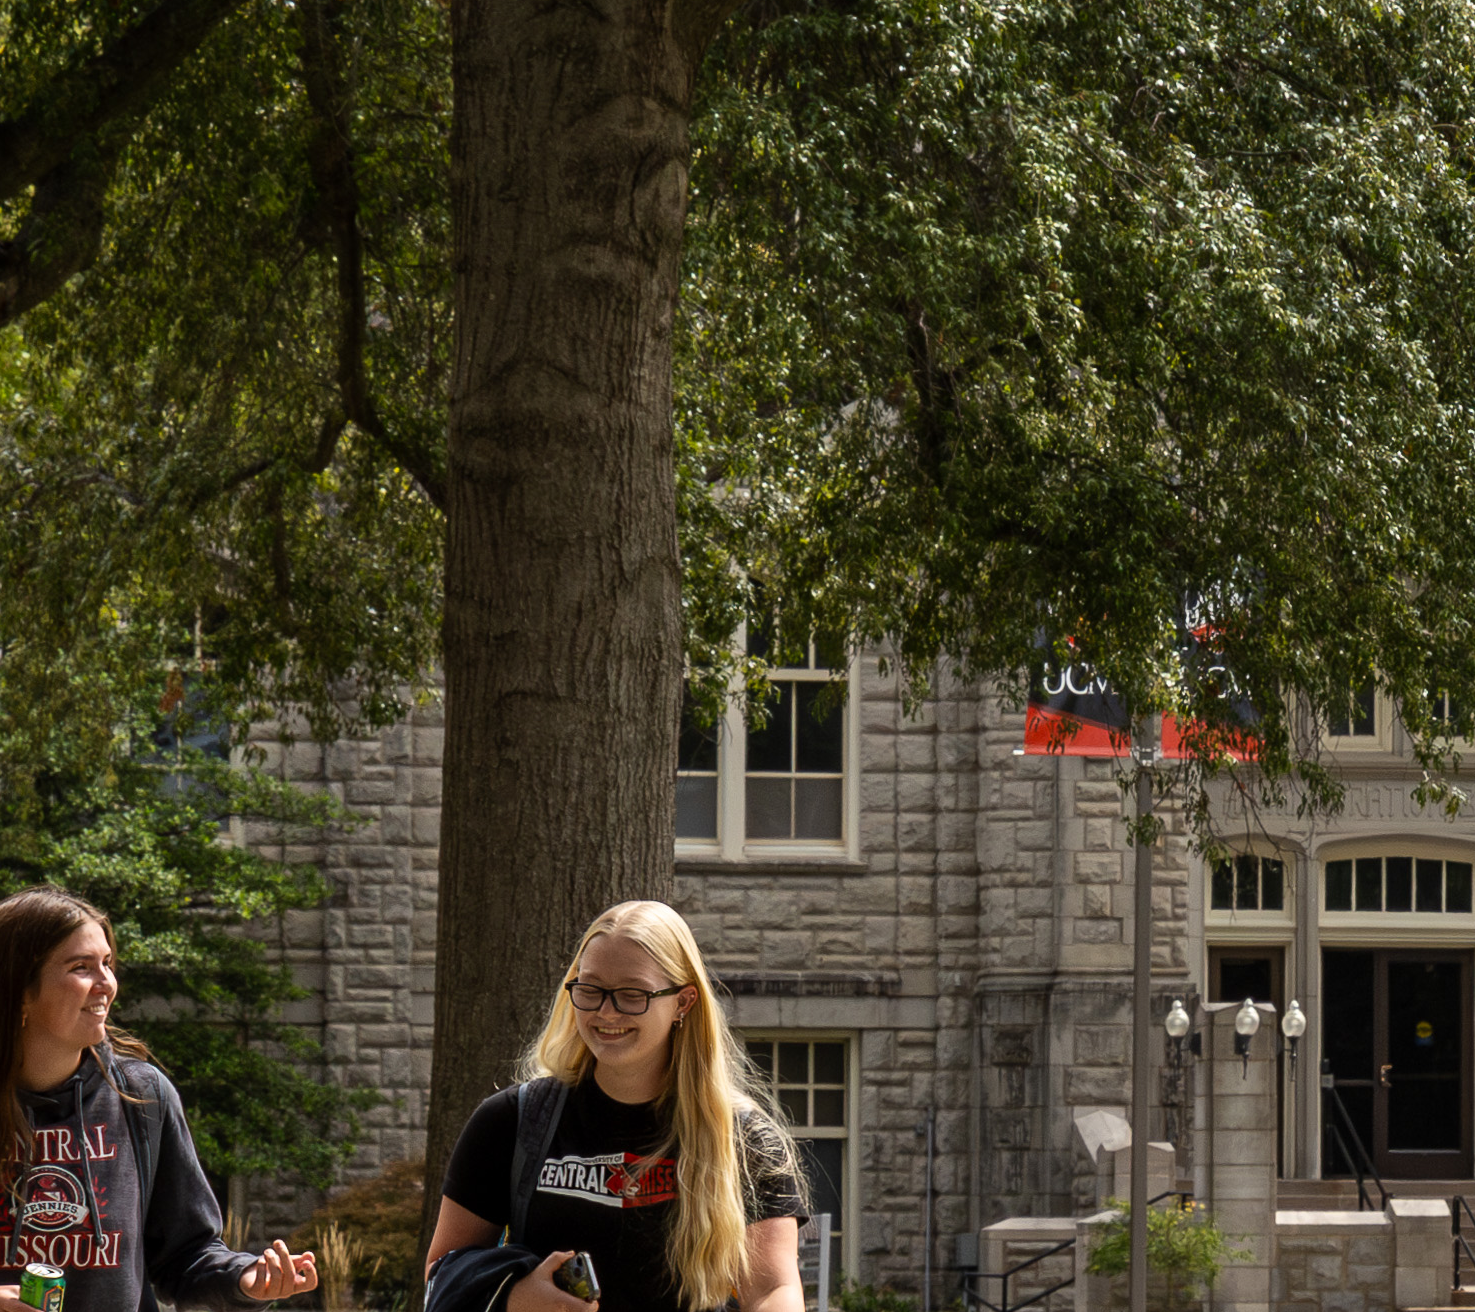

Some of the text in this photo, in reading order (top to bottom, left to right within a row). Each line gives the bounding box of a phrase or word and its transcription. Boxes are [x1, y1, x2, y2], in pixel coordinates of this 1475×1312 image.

[540, 1162, 675, 1195] CENTRAL MISS
[23, 1202, 78, 1215] JENNIES
